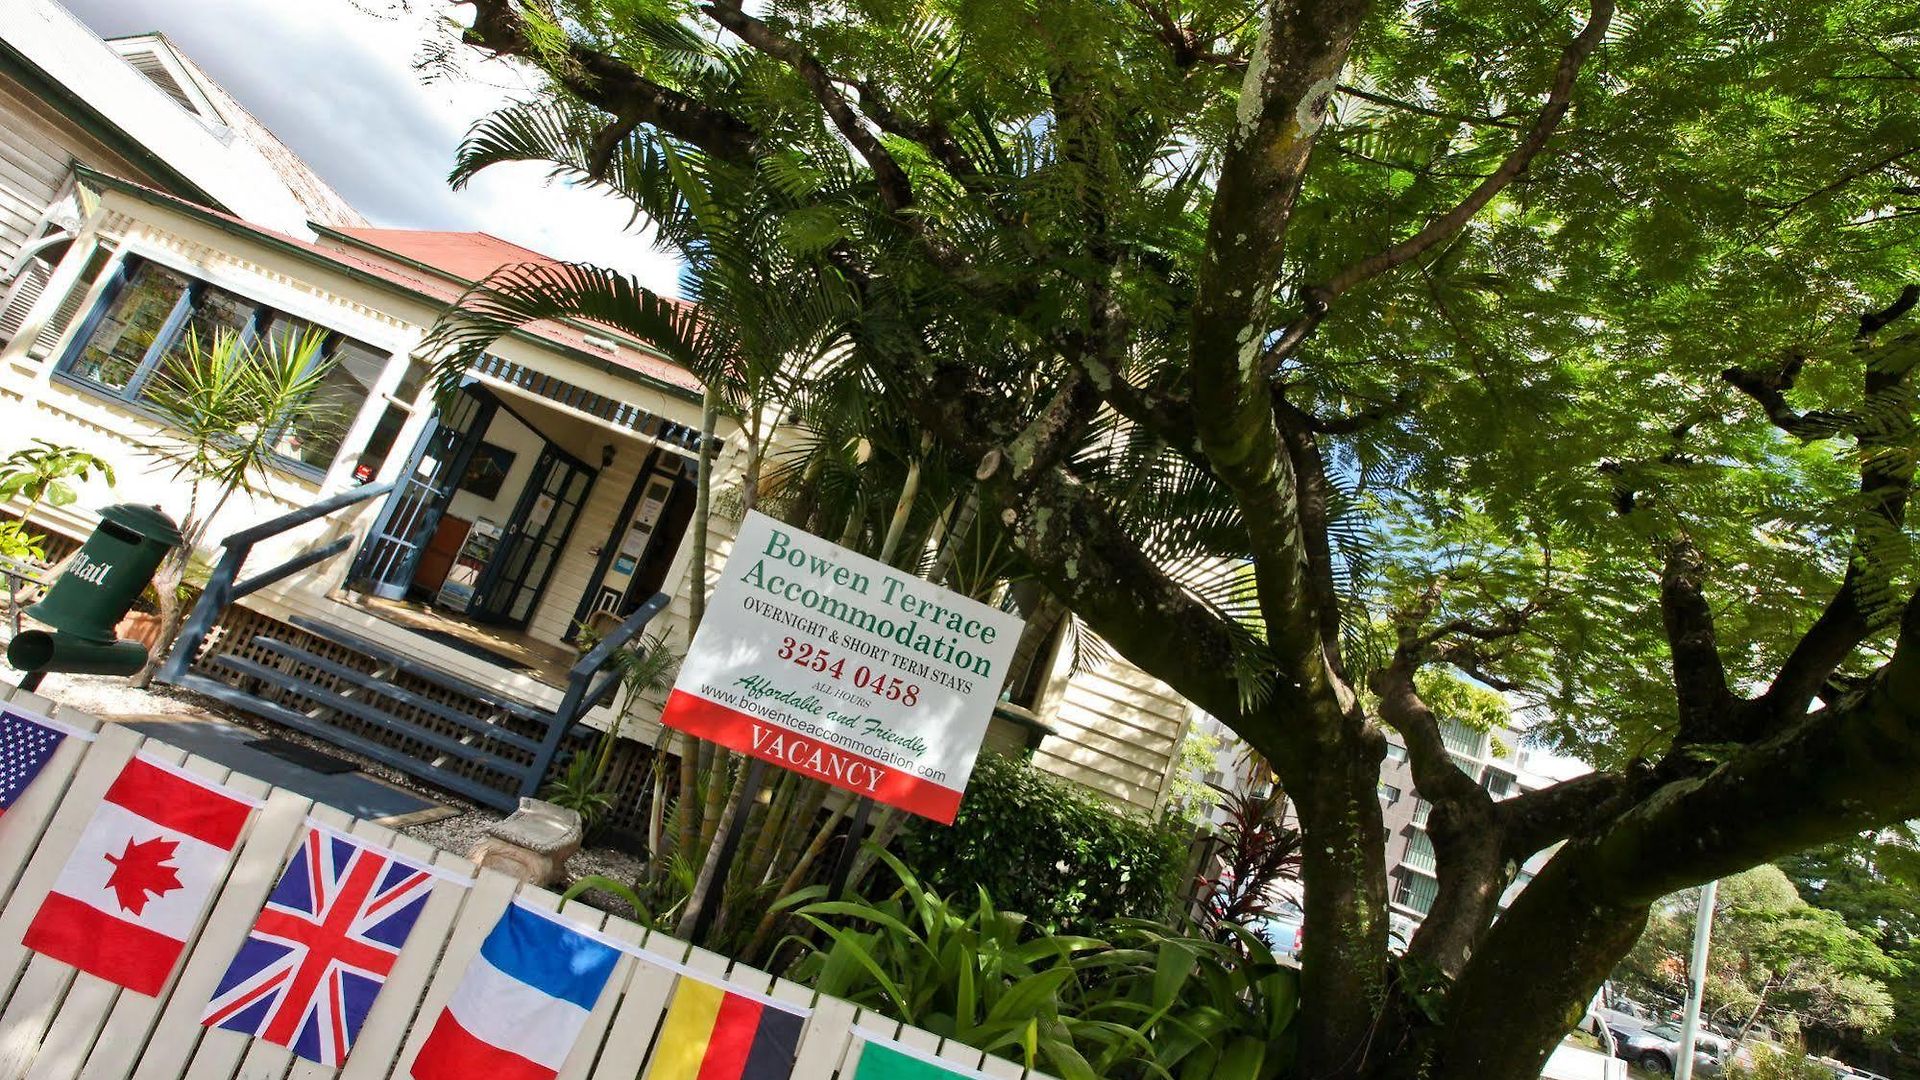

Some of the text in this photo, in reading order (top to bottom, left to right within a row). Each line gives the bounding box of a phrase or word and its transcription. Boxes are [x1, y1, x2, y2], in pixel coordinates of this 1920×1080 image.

[741, 560, 993, 678] Accommodation
[763, 529, 997, 644] Bowen Terrace
[743, 596, 973, 695] OVERNIGHT & SHORT TERM STAYS
[778, 636, 921, 708] 3254 0458
[701, 683, 946, 782] www.bowentceaccommodationcom
[734, 673, 928, 757] Affordable and Friendly
[812, 681, 871, 708] ALL HOURS
[750, 723, 886, 793] VACANCY
